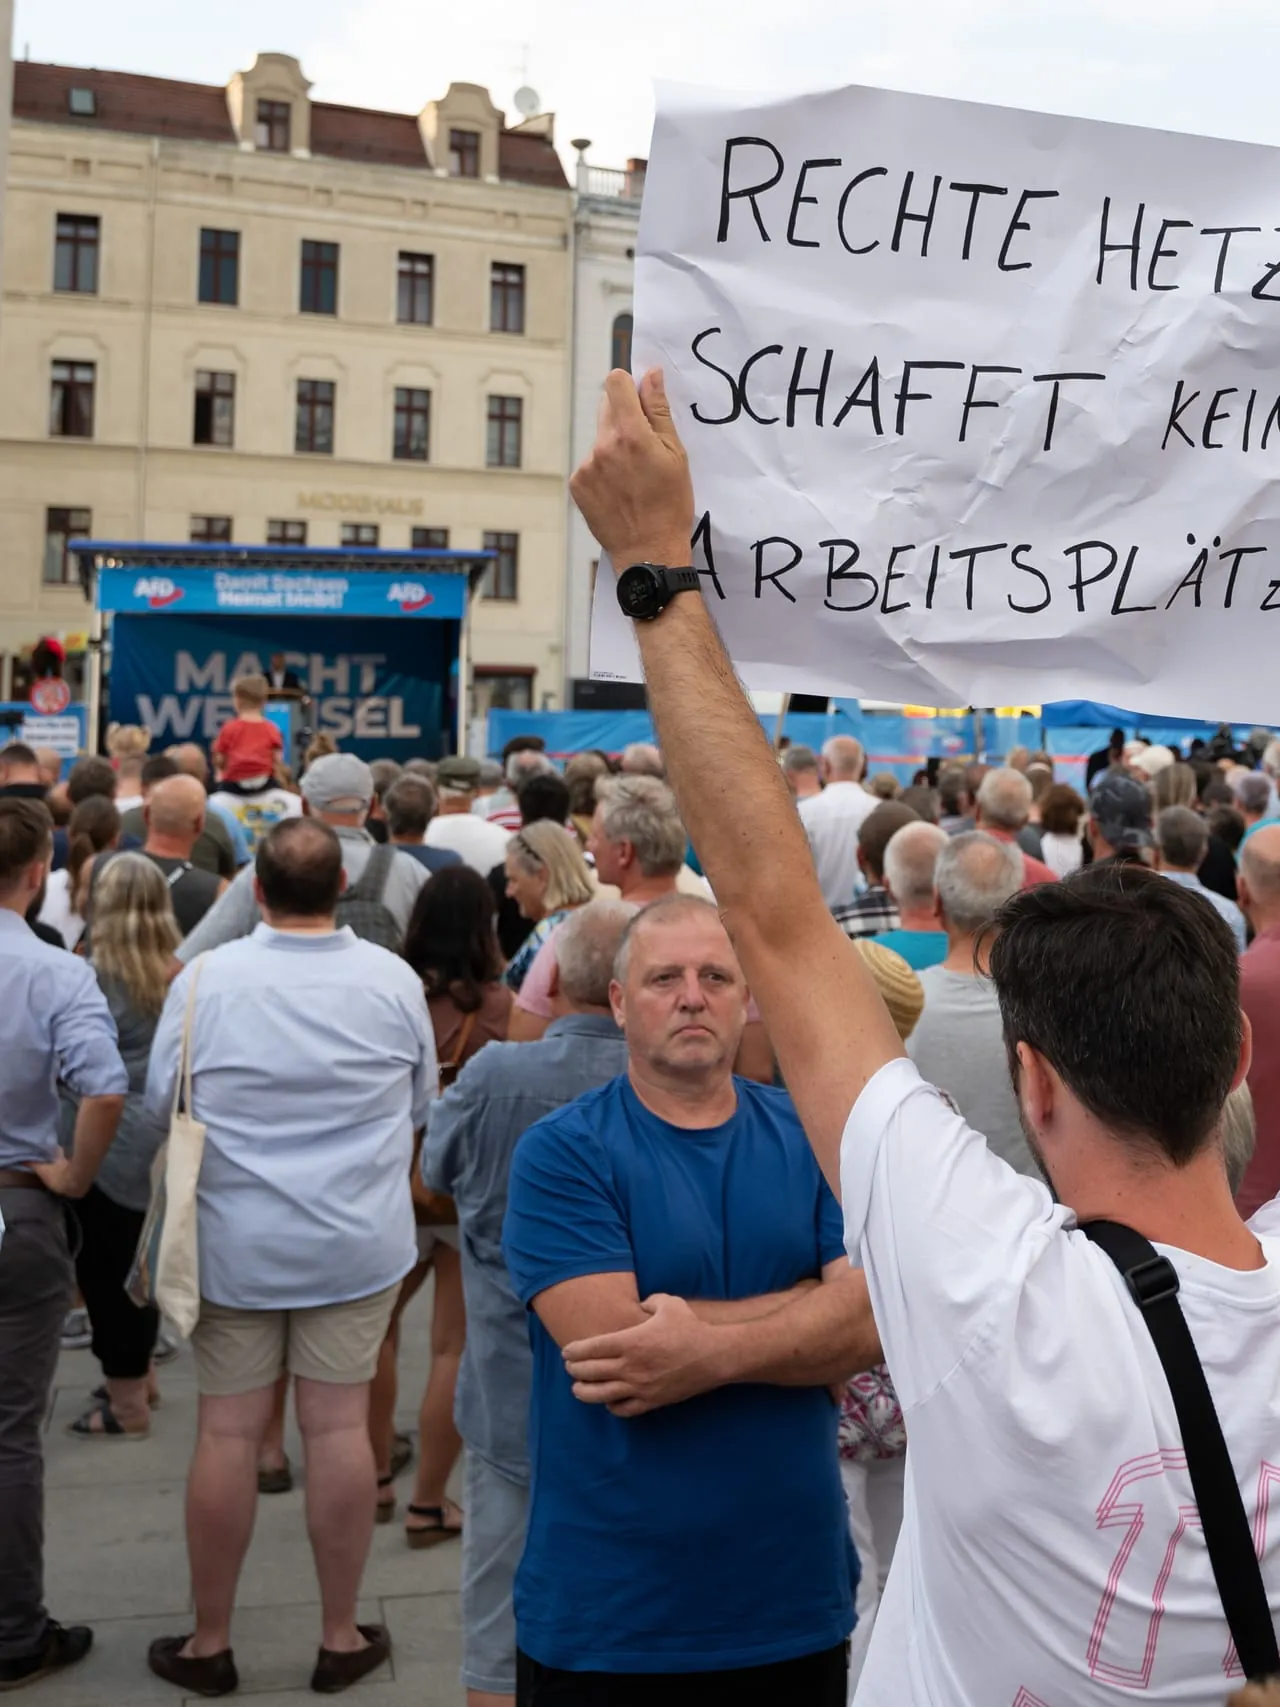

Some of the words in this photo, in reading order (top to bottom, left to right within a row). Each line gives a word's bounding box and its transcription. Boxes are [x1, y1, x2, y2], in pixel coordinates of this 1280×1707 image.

[717, 136, 1060, 272] RECHTE
[689, 327, 1106, 452] SCHAFFT
[134, 692, 420, 738] WESEL
